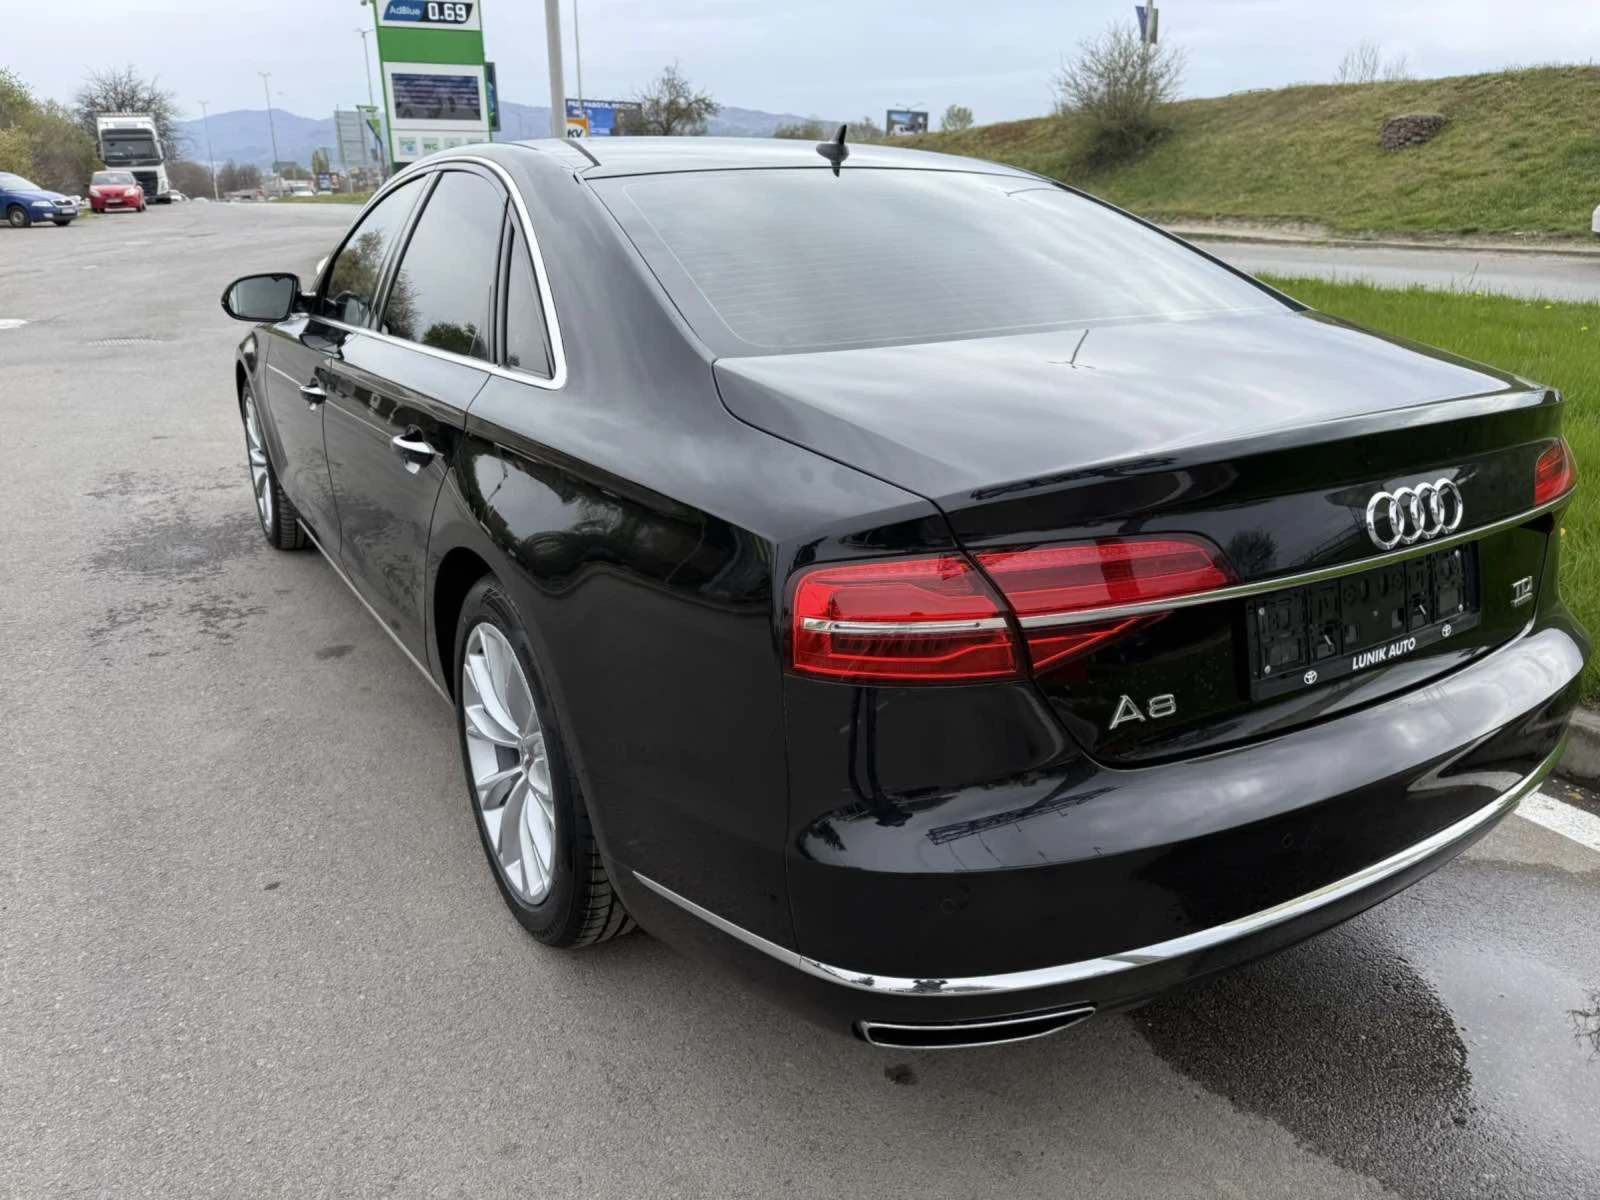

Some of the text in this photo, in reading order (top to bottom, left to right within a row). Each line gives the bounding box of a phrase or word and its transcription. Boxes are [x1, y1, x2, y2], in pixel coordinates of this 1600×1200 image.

[389, 2, 467, 21] AdBlue 0.69
[423, 143, 438, 151] WC
[1352, 637, 1416, 671] LUNIK AUTO
[1108, 694, 1177, 730] A8
